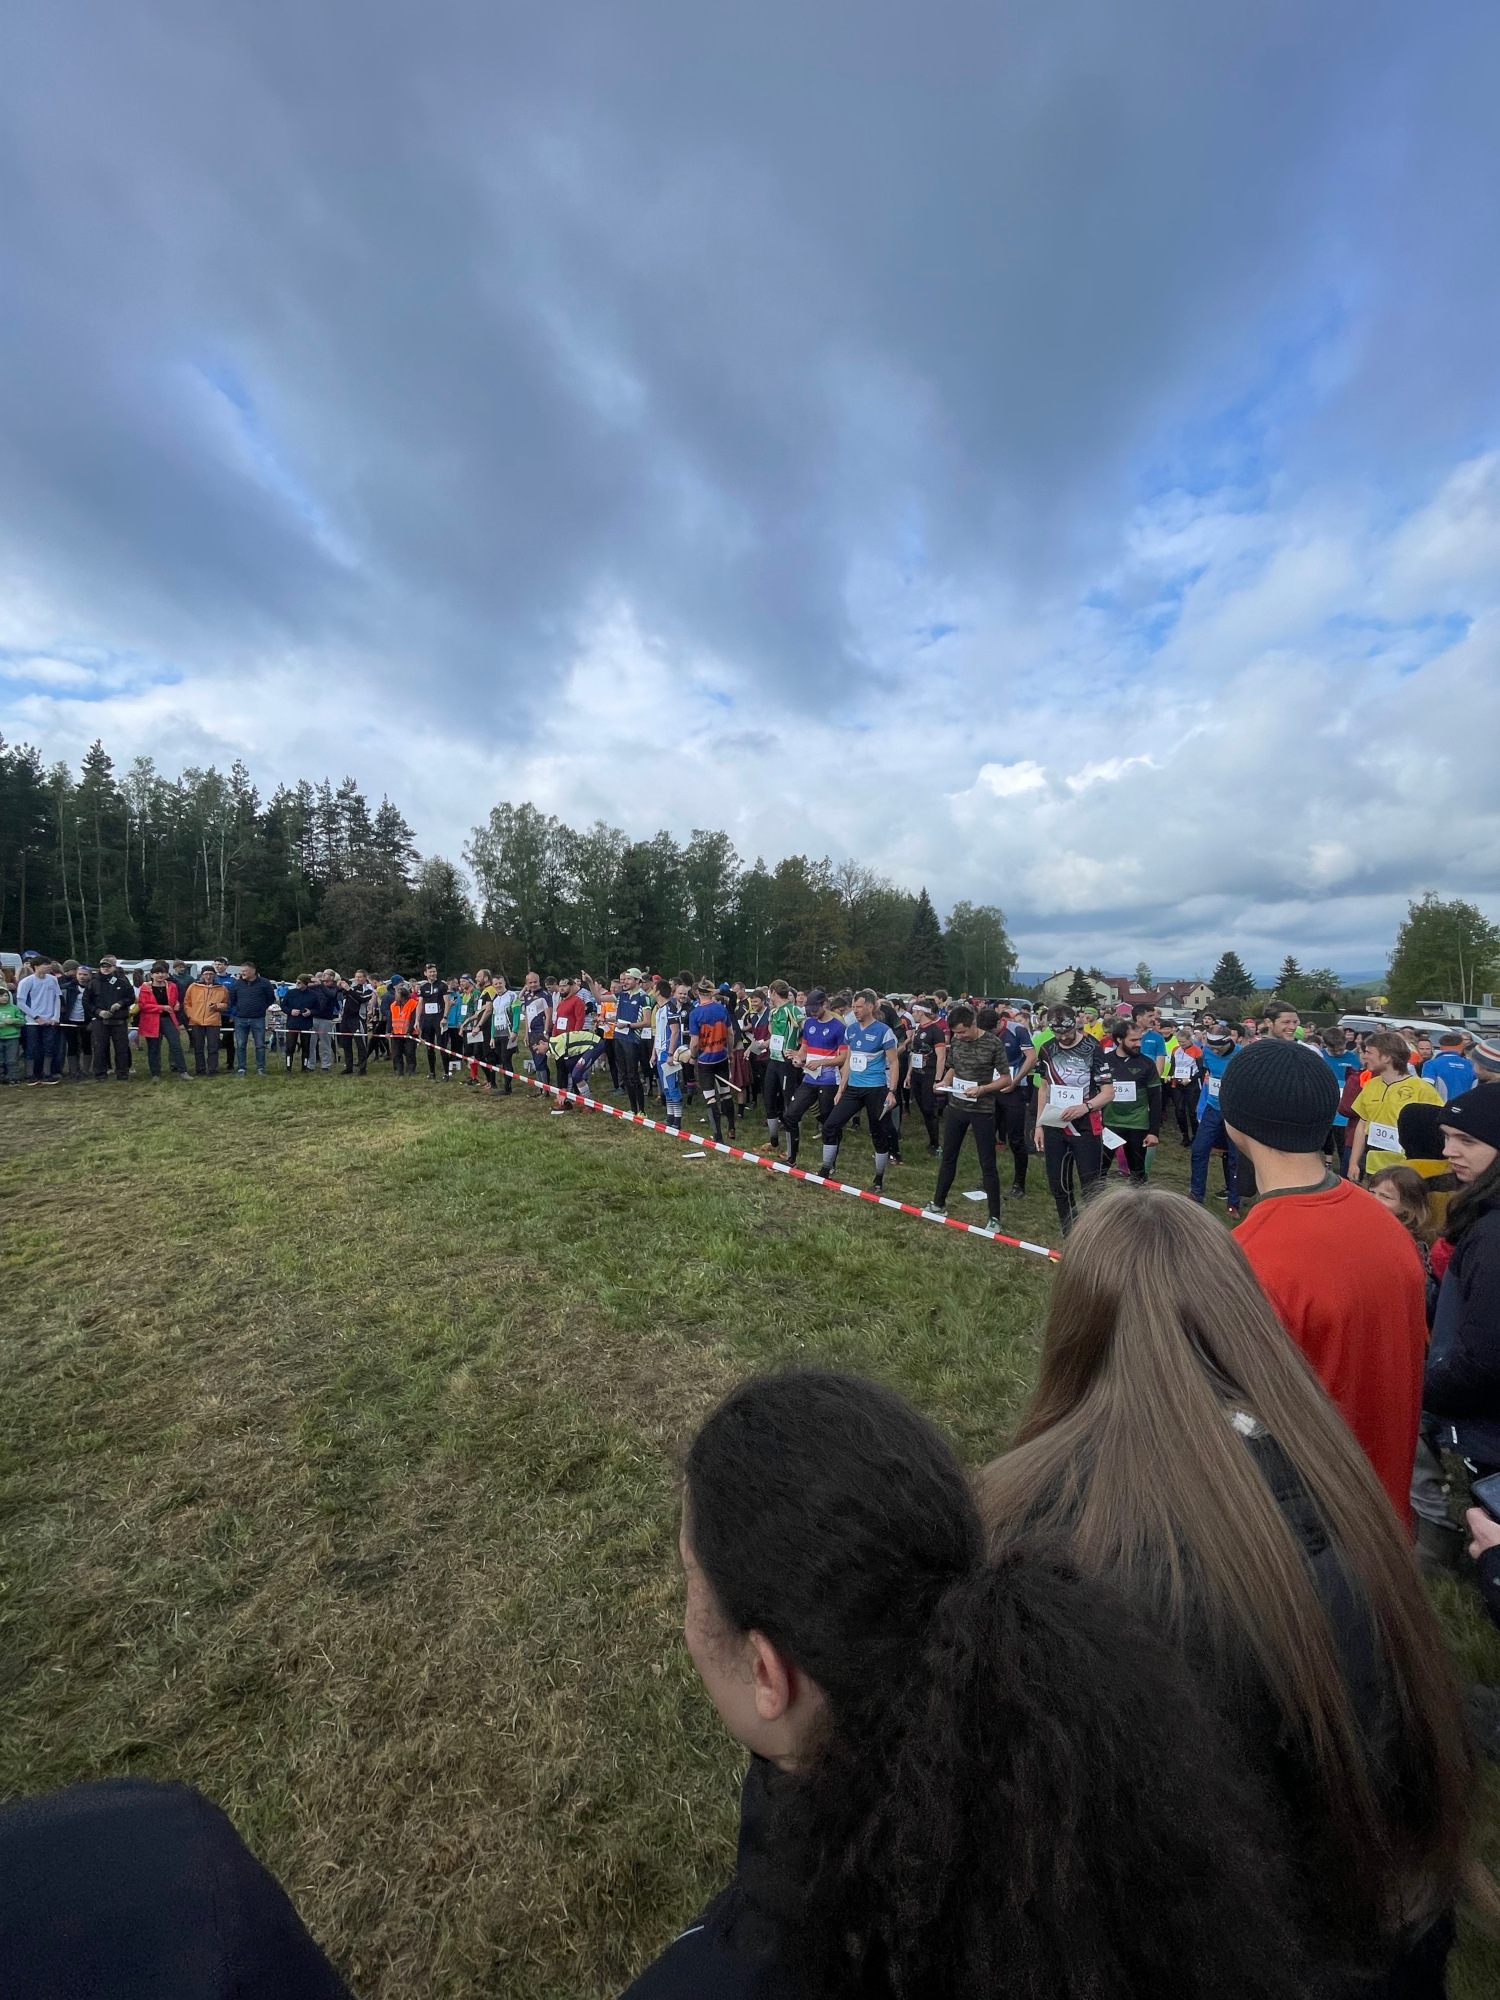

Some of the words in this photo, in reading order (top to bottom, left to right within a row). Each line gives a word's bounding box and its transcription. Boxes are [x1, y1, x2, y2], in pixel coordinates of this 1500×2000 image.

[957, 1083, 965, 1091] 14
[1057, 1090, 1068, 1099] 15
[1376, 1128, 1387, 1138] 30
